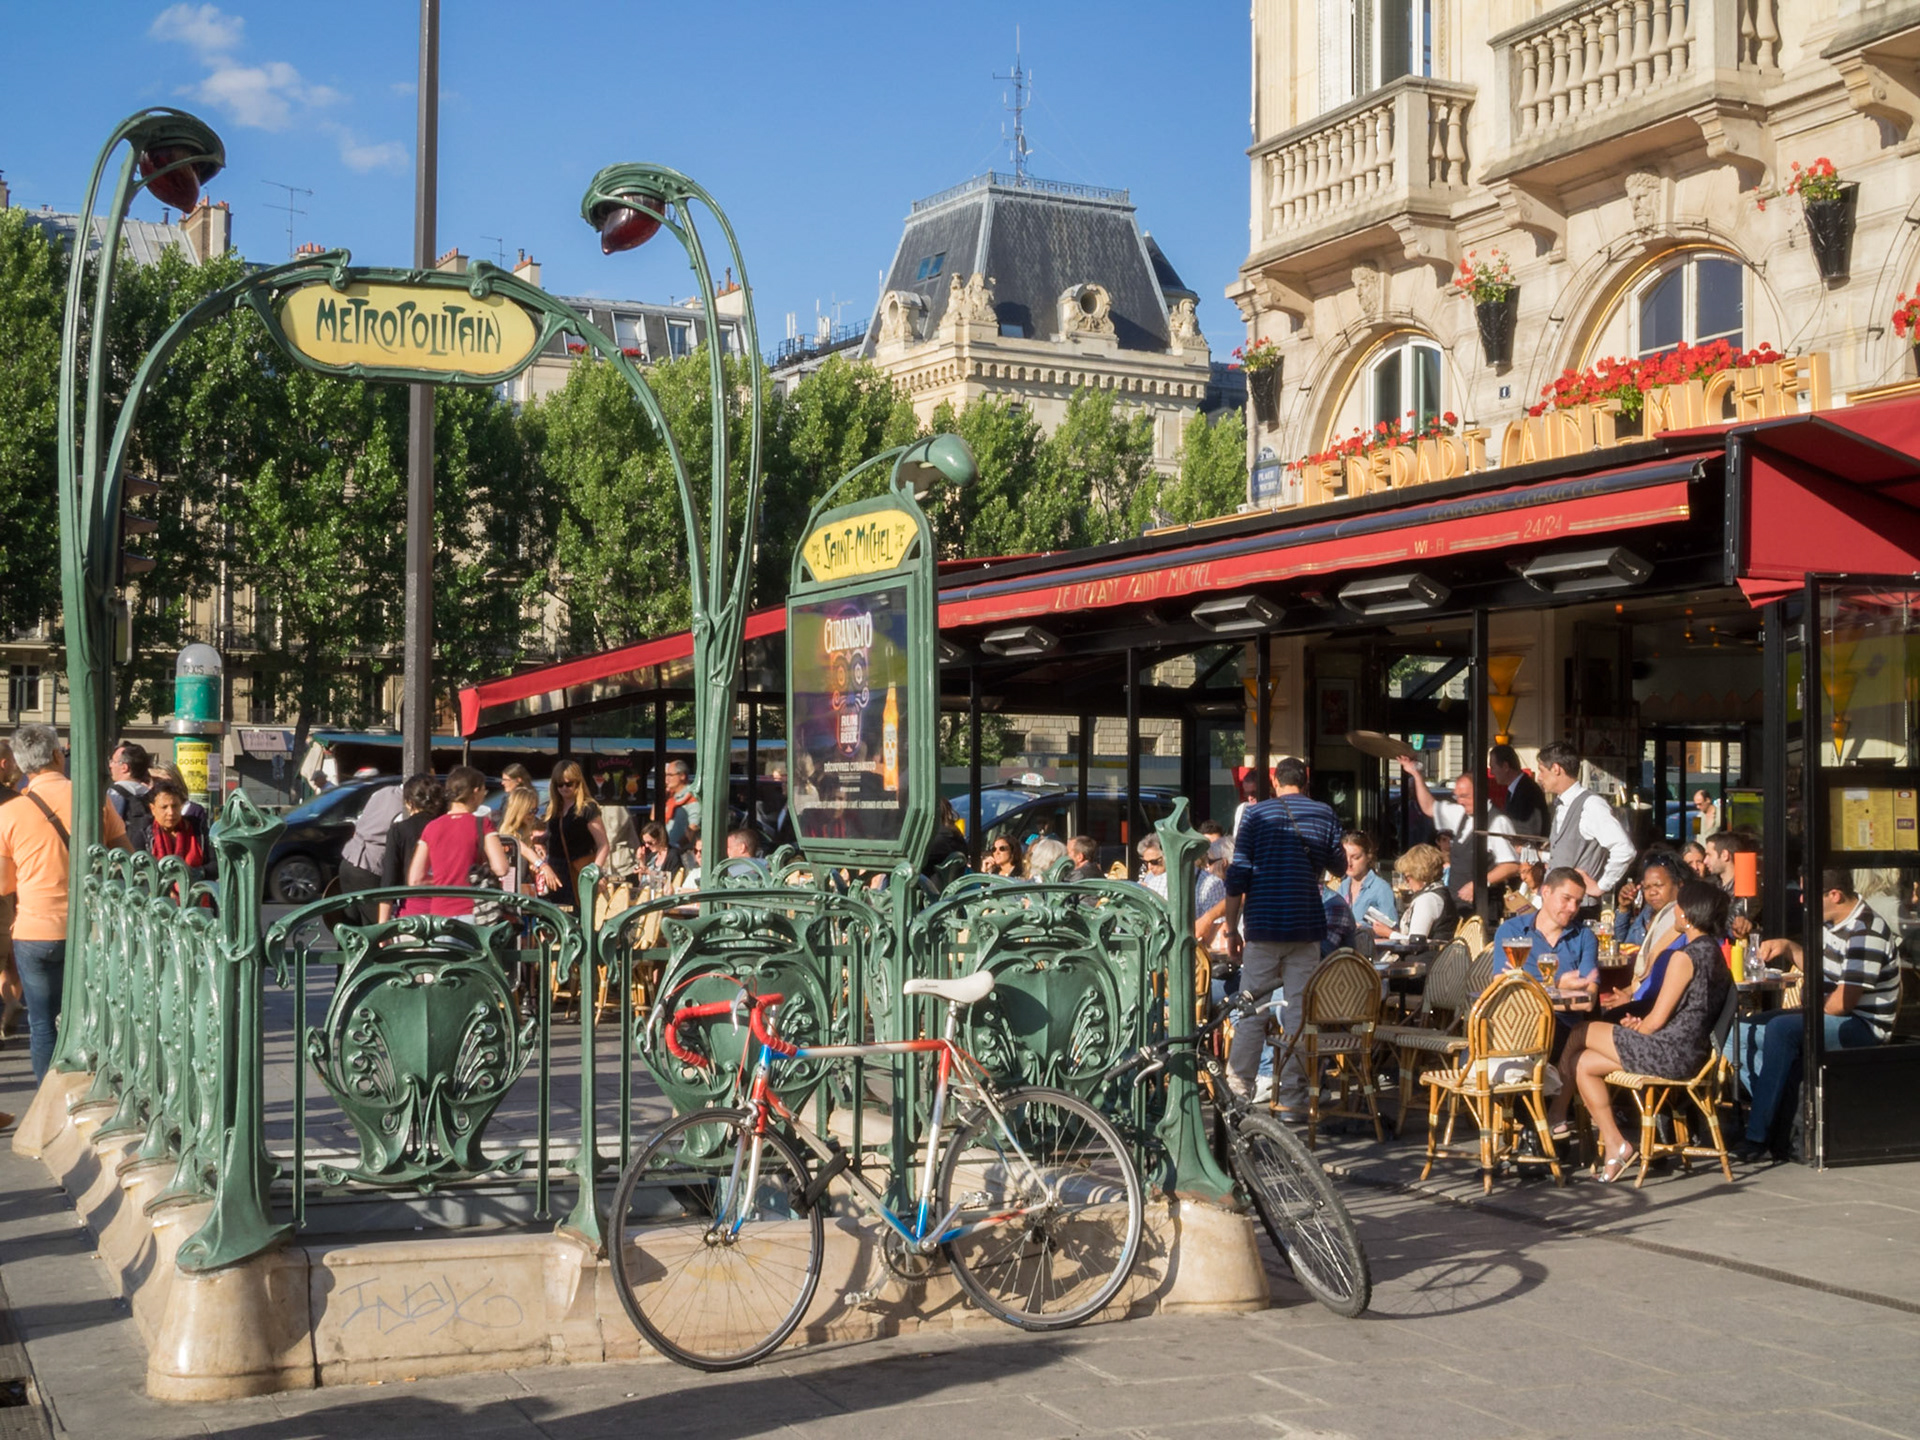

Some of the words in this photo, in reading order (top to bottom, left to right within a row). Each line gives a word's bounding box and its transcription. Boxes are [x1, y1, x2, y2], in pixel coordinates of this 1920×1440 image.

[316, 297, 501, 357] METROPOLITAIN
[823, 522, 894, 573] SAINT-MICHEL
[1055, 587, 1071, 610] LE
[1124, 571, 1163, 600] SAINT
[1166, 564, 1212, 593] MICHEL
[1523, 514, 1562, 539] 24/24
[824, 611, 873, 654] CUBANISTO
[183, 665, 204, 675] TAXIS
[840, 714, 859, 727] RUM
